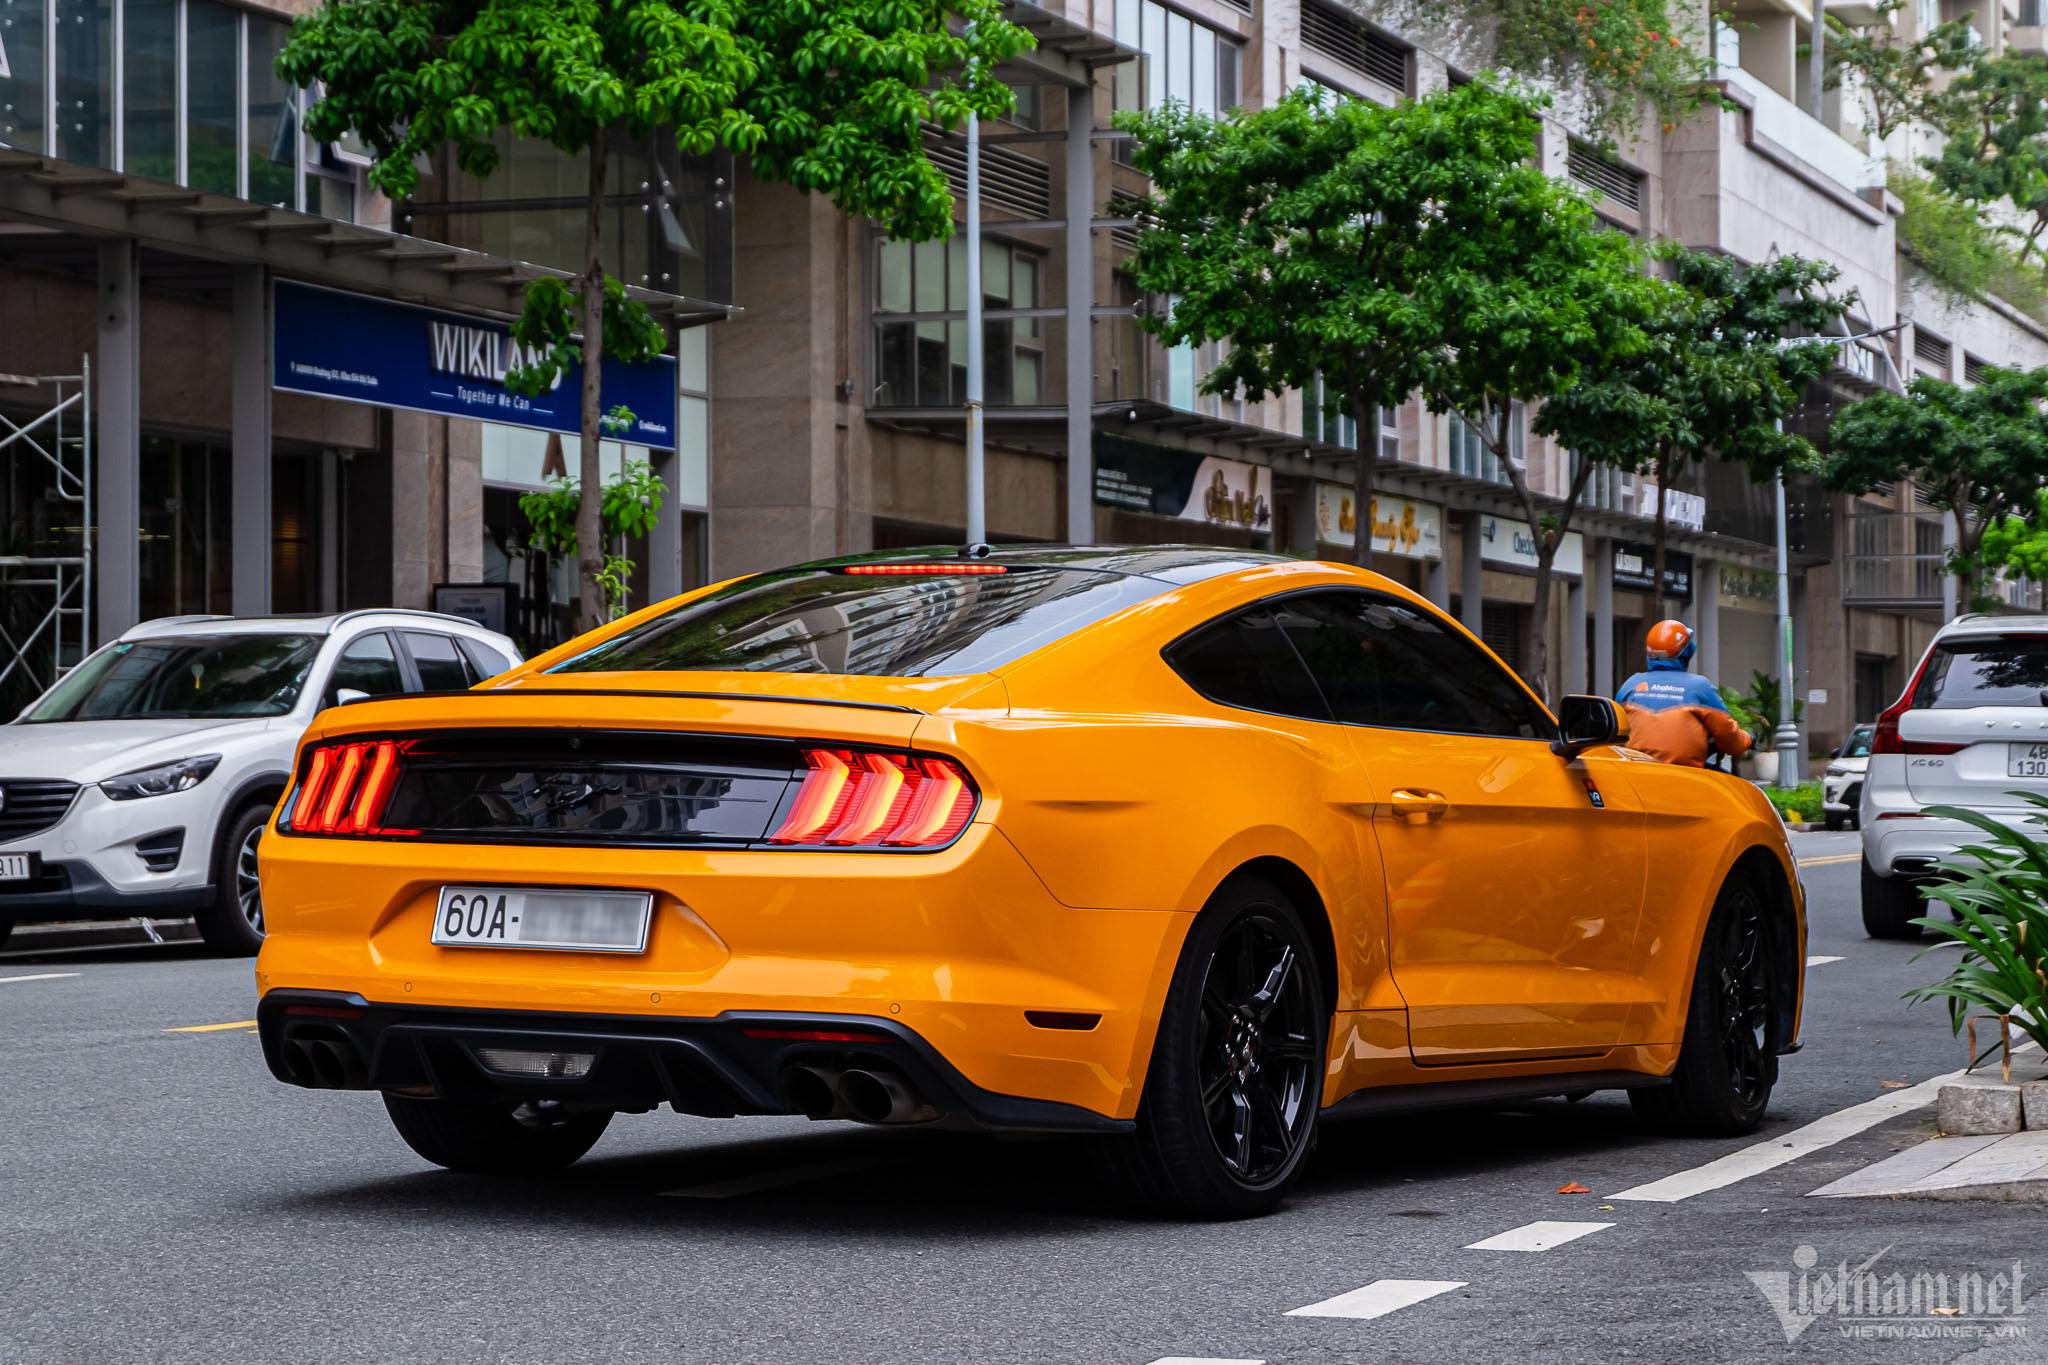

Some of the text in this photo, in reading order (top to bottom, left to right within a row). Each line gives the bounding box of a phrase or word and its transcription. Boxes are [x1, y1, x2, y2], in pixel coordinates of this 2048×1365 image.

[457, 385, 530, 410] Together We Can
